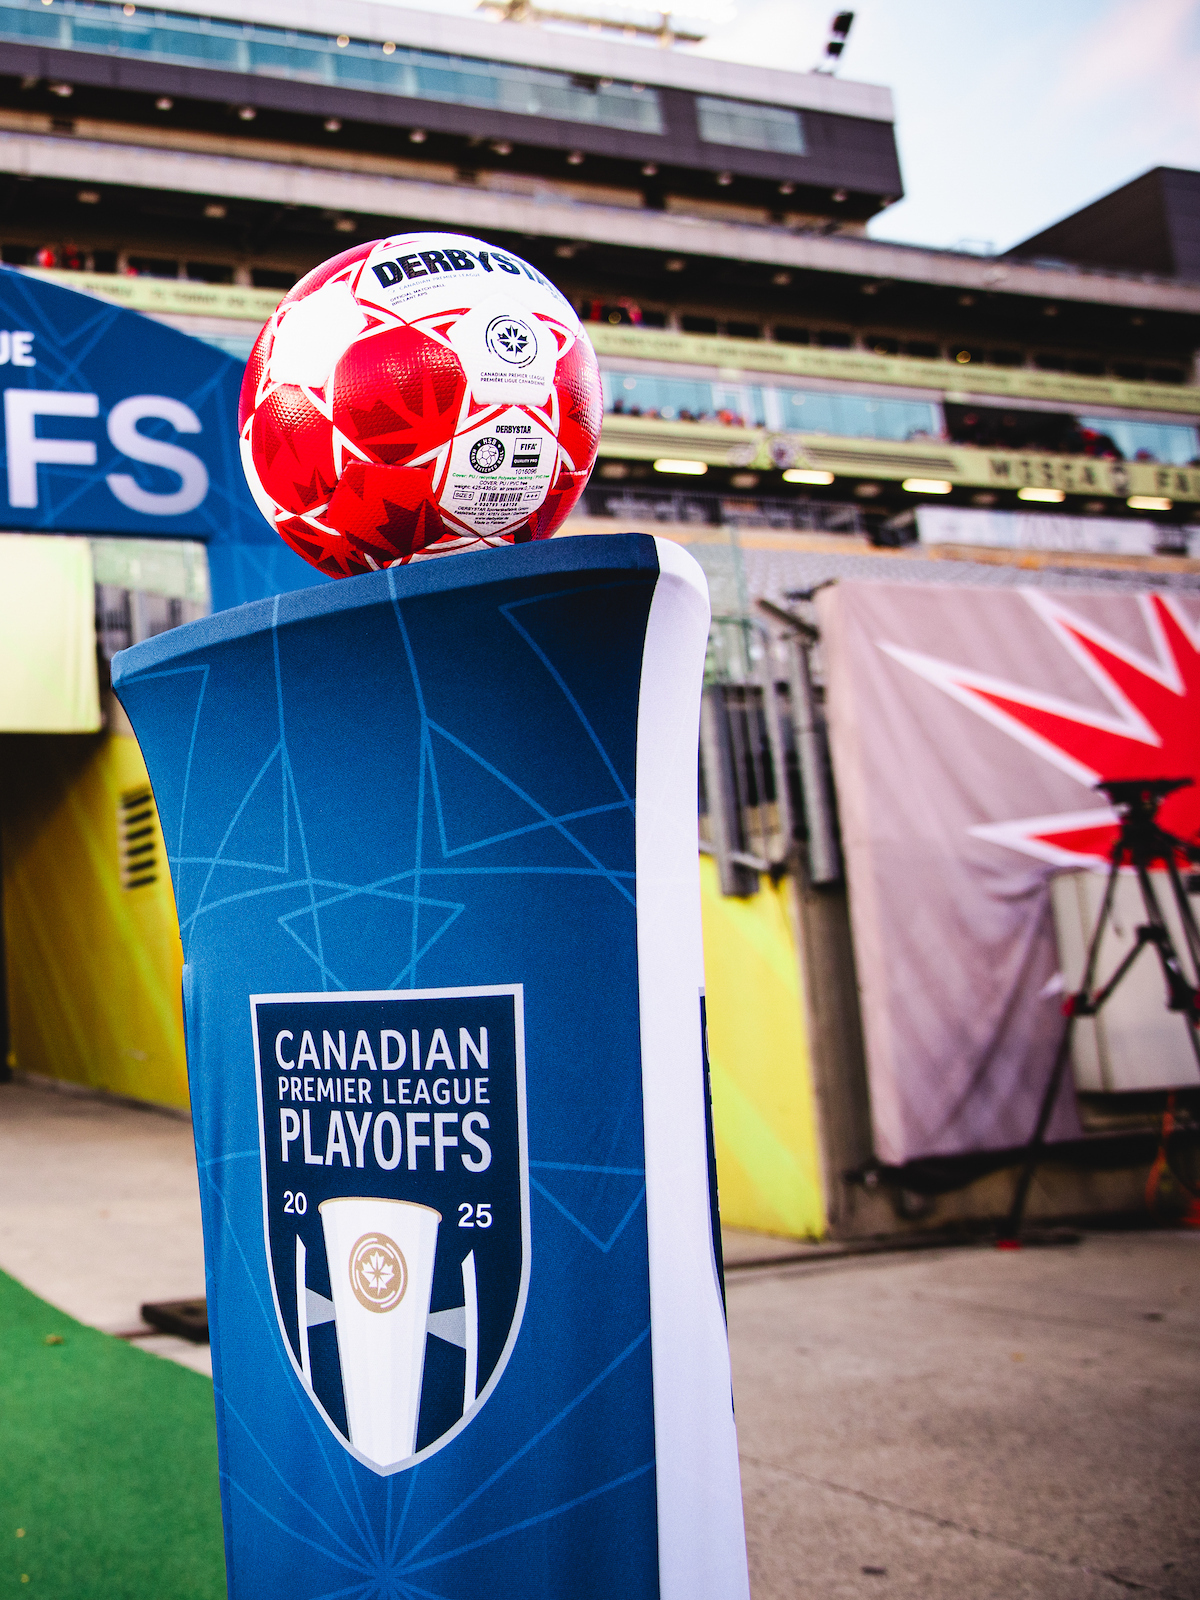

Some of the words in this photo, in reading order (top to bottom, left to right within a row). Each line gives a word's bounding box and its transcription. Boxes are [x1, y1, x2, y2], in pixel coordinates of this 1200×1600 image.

[496, 426, 532, 434] DERBYSTAR
[275, 1026, 489, 1071] CANADIAN
[278, 1076, 373, 1104] PREMIER
[382, 1077, 491, 1105] LEAGUE
[279, 1107, 492, 1172] PLAYOFFS
[283, 1190, 307, 1215] 20
[457, 1202, 493, 1228] 25
